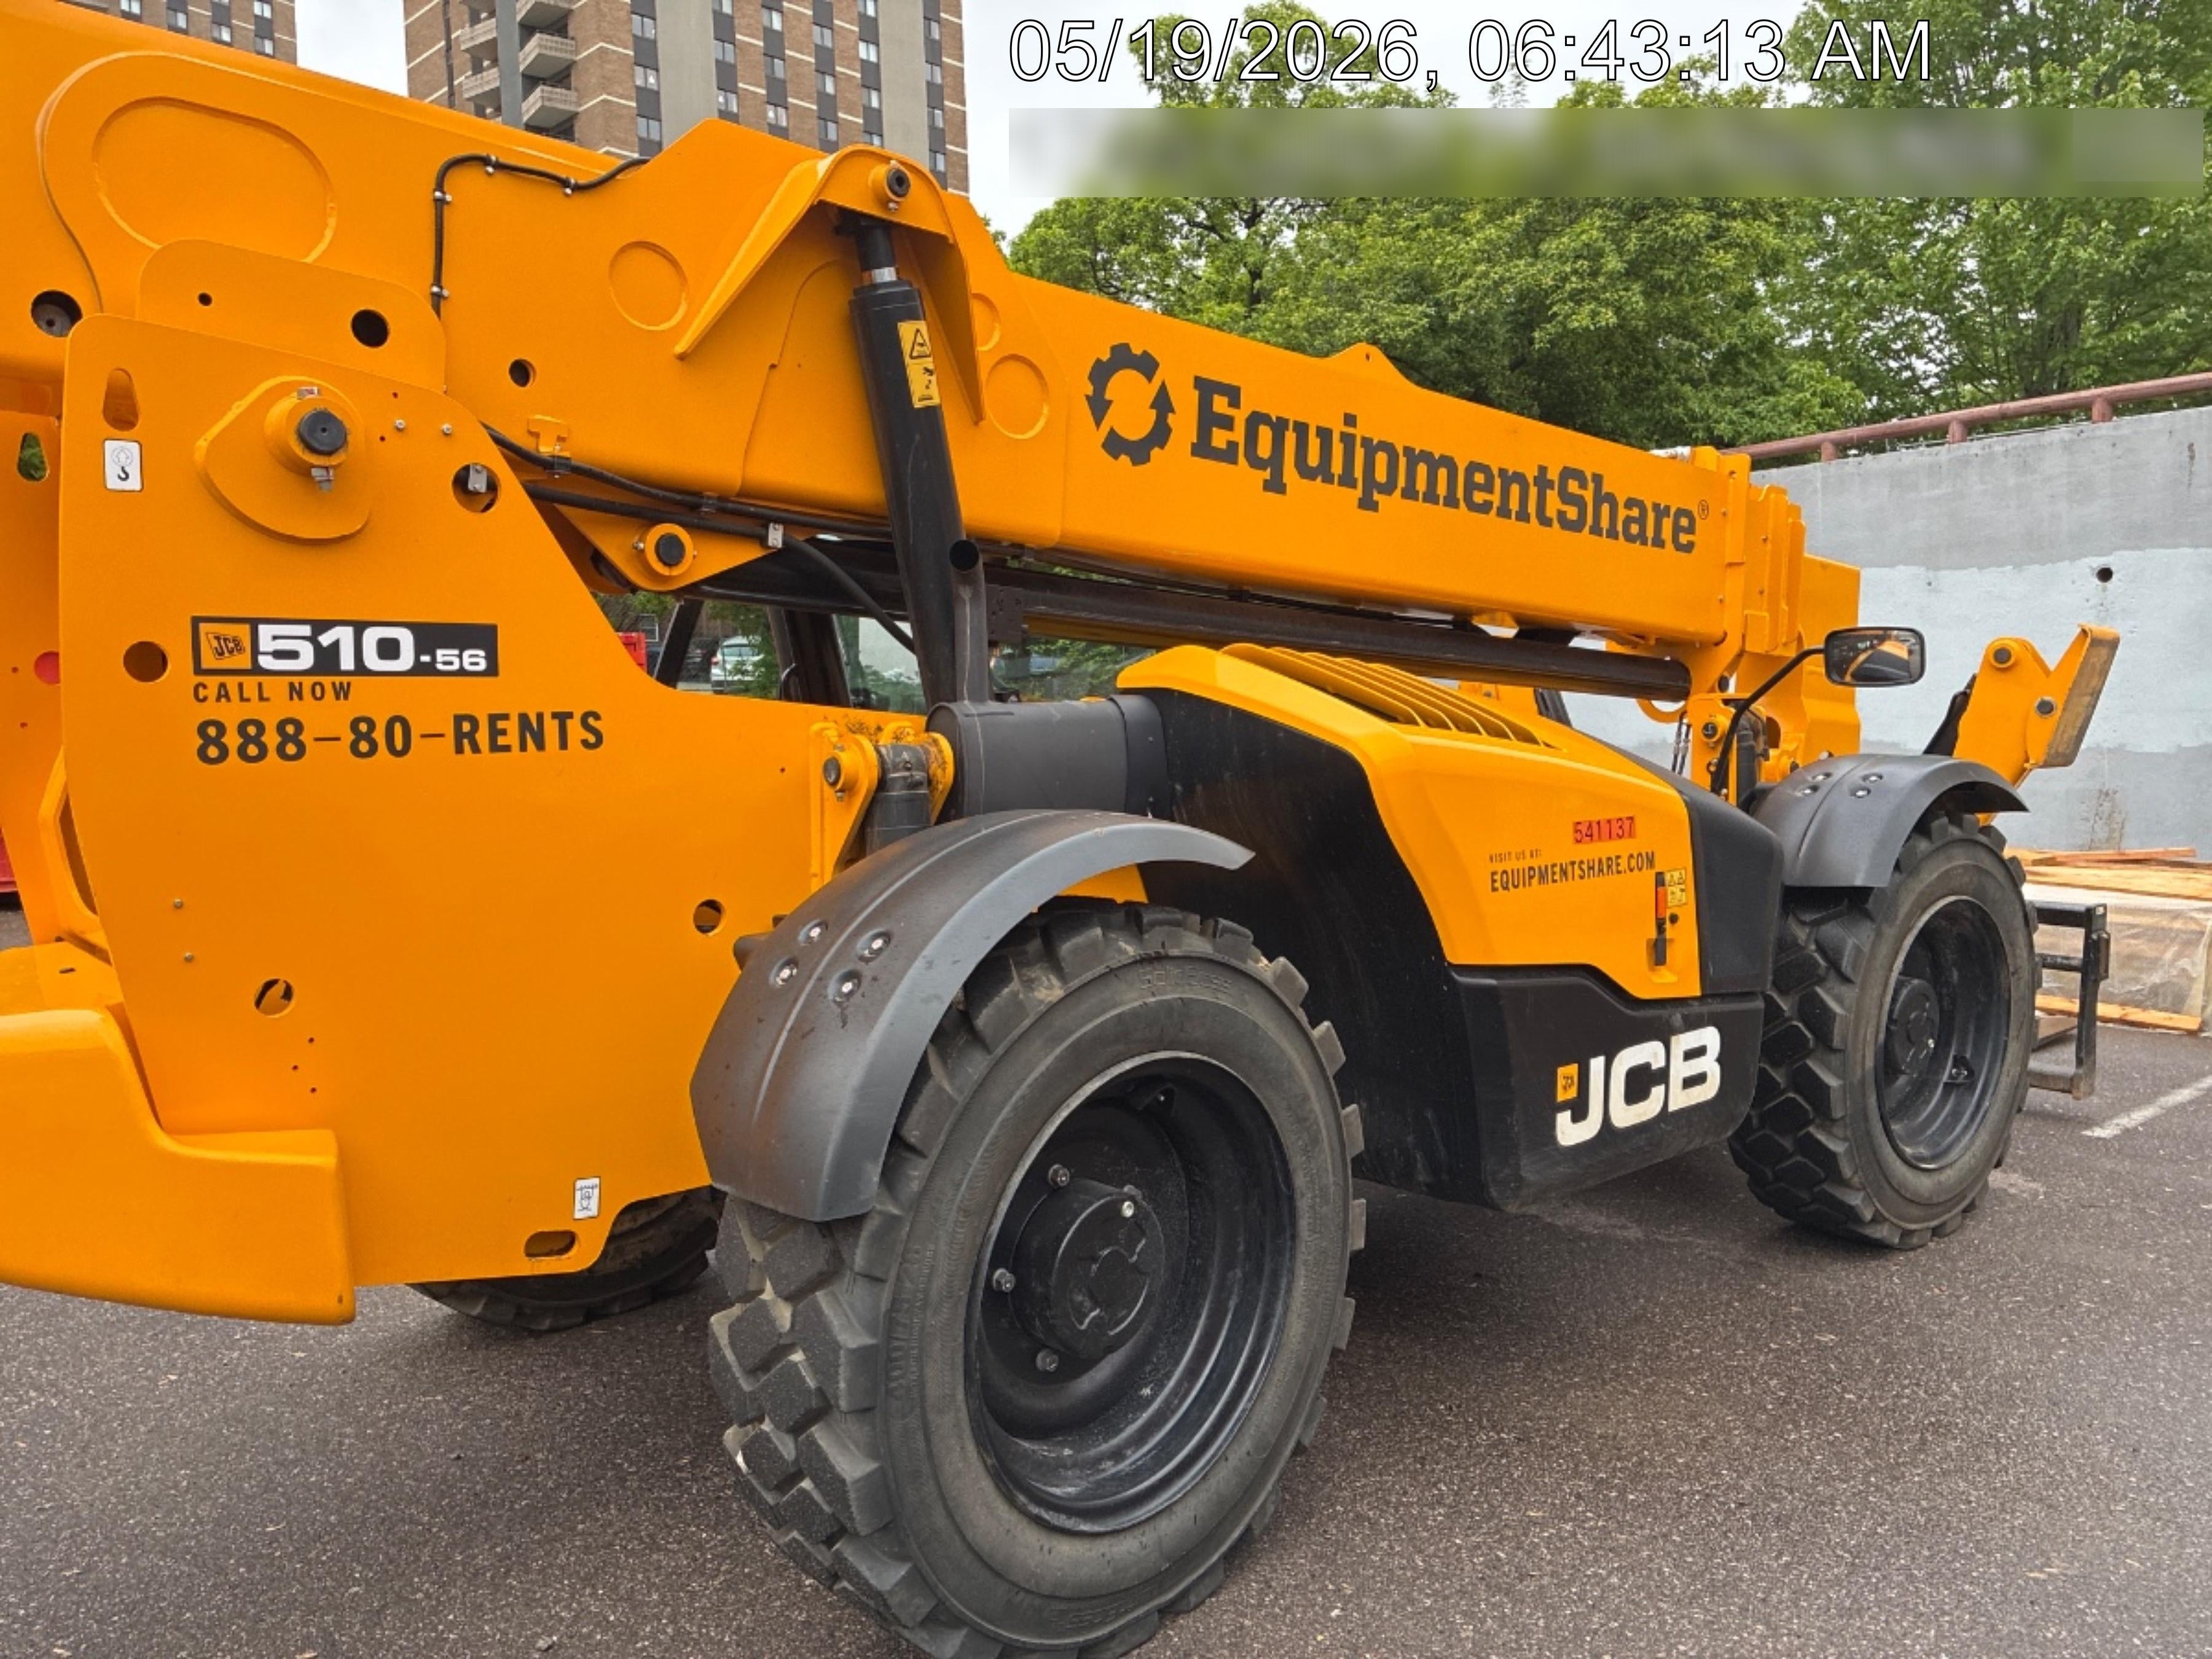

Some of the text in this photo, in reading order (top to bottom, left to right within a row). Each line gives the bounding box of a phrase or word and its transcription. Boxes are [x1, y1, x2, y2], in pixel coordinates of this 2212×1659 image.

[213, 624, 487, 672] JCB 510-56
[193, 681, 352, 704] CALL NOW
[196, 710, 604, 766] 888-80-RENTS
[1574, 816, 1634, 843] 541137
[1491, 850, 1656, 893] EQUIPMENTSHARE.COM
[1556, 1026, 1720, 1147] JCB
